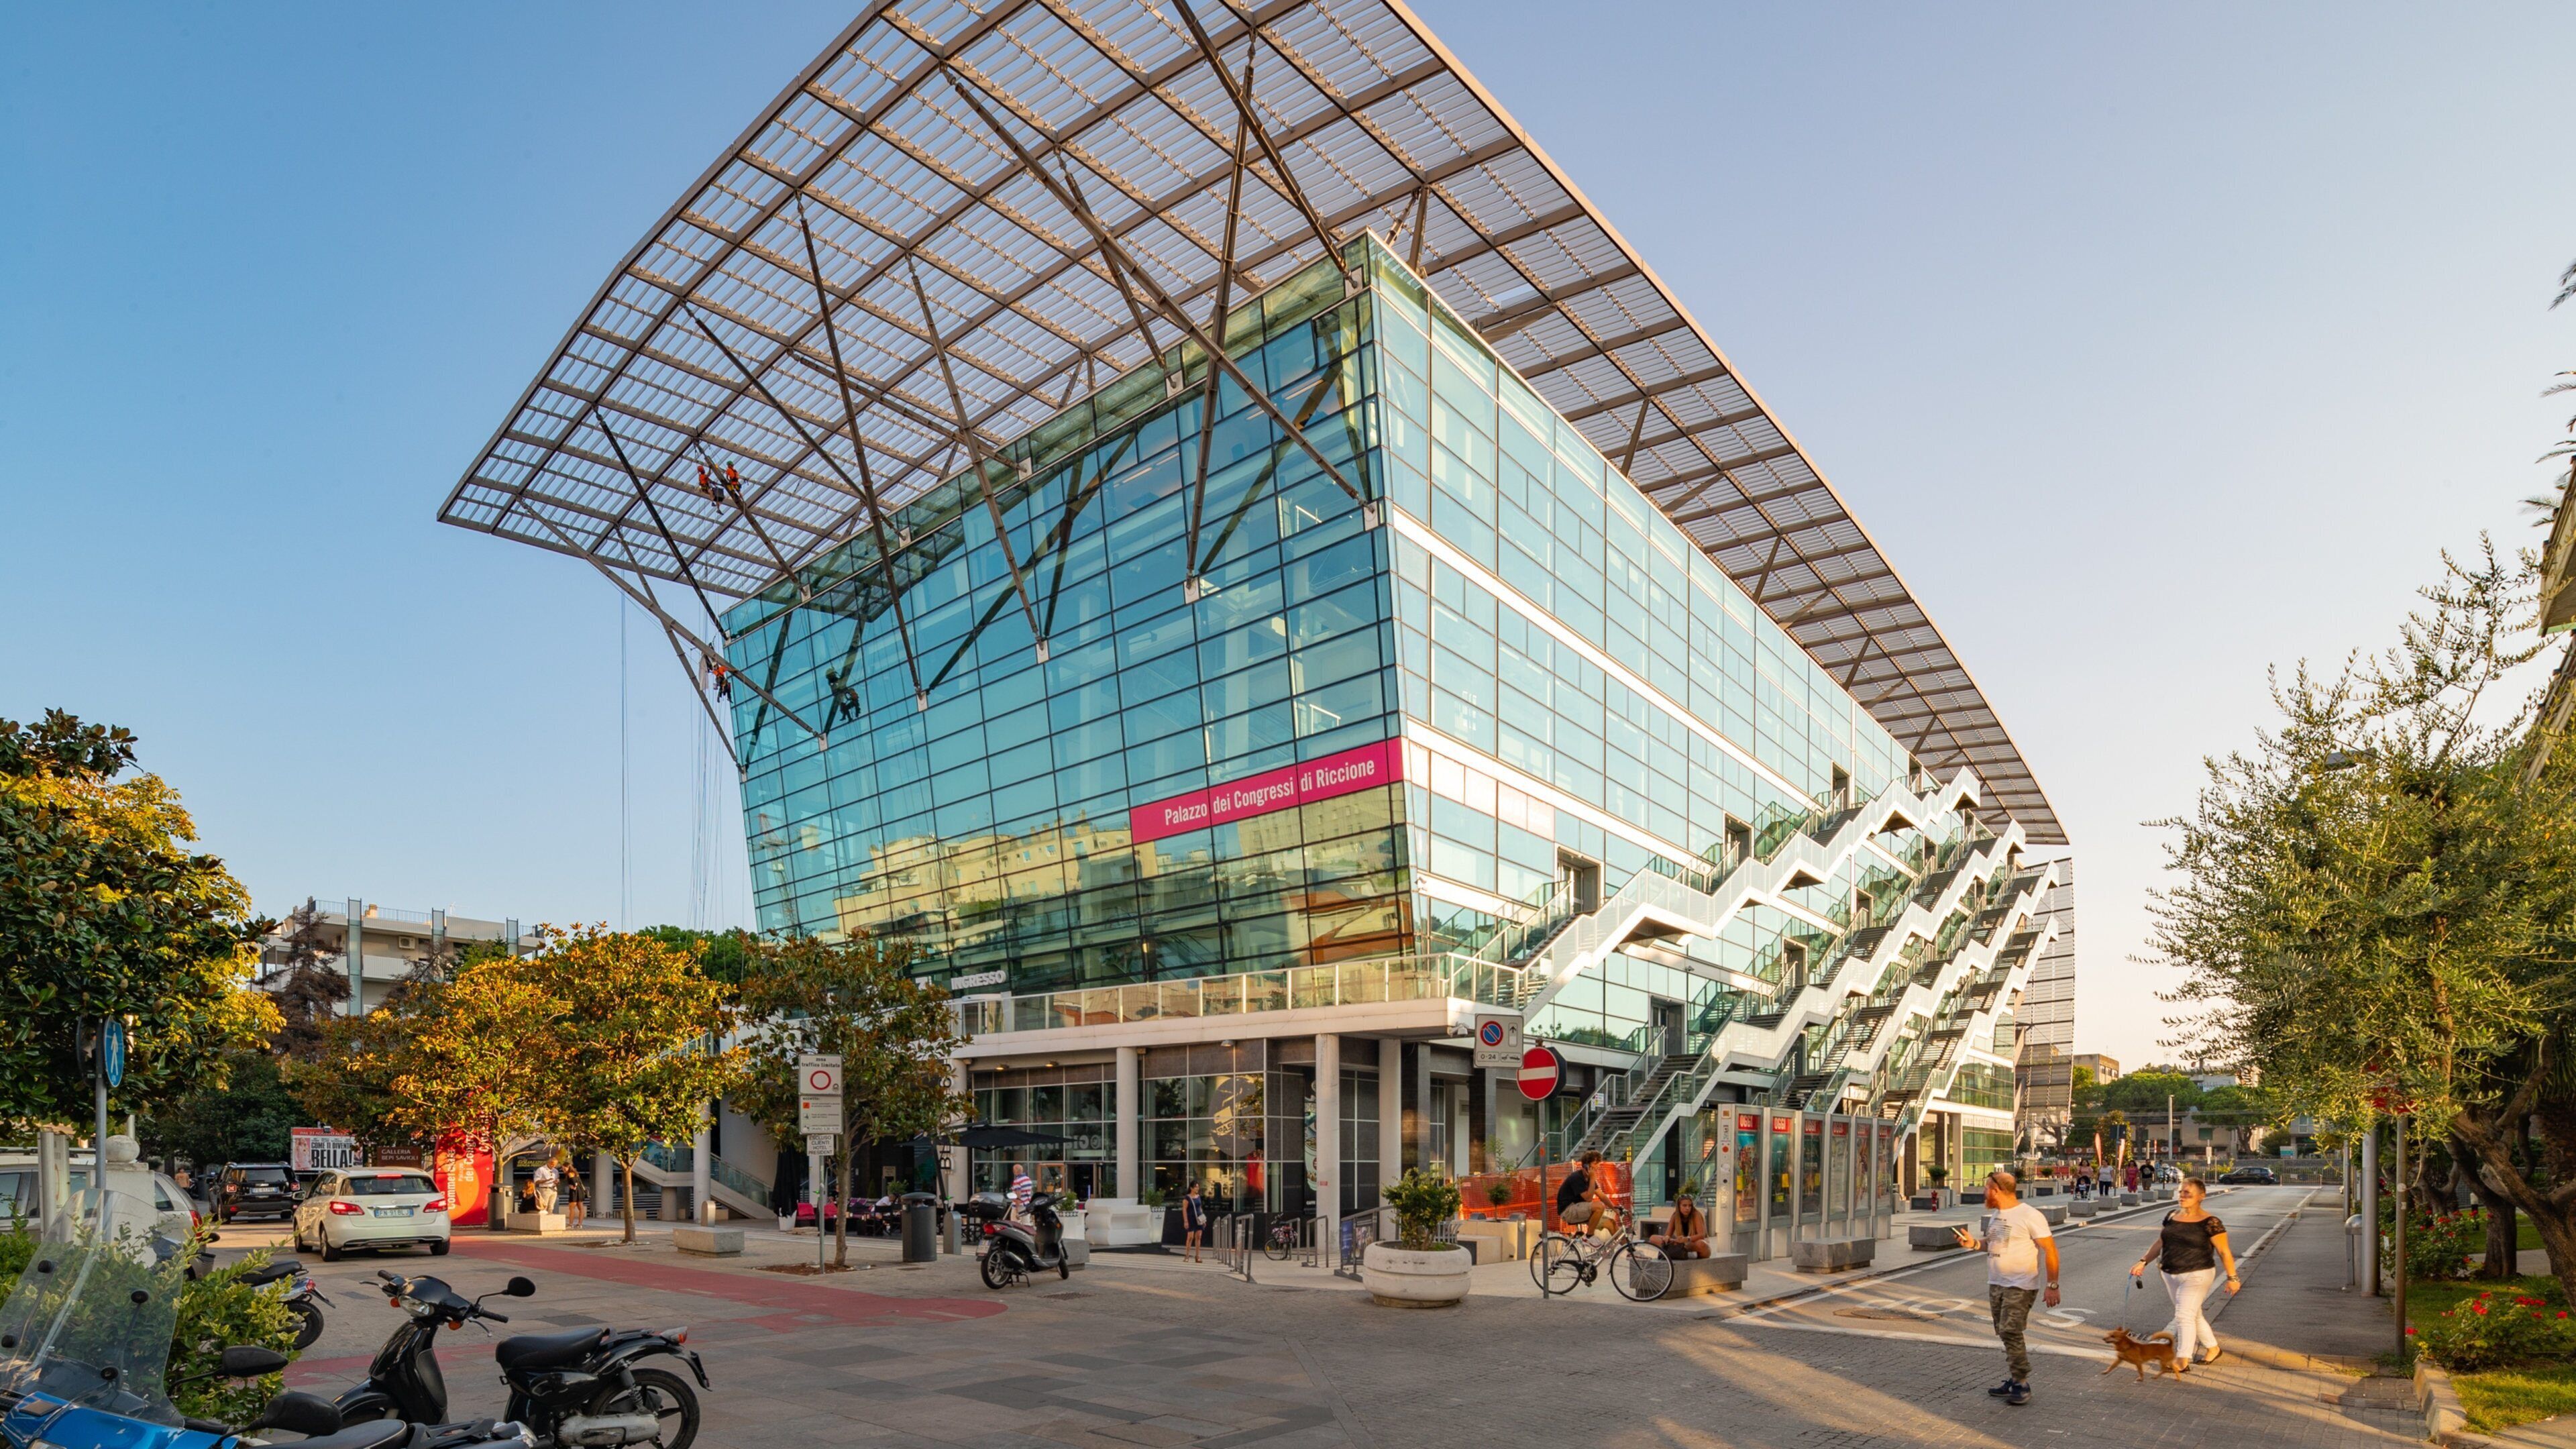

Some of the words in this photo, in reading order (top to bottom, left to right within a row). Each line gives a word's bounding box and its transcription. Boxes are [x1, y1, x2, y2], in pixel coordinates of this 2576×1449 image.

[1165, 803, 1208, 826] Palazzo
[1213, 794, 1231, 814] dei
[1233, 777, 1295, 808] Congressi
[1300, 773, 1313, 792] di
[1316, 759, 1375, 788] Riccione
[951, 970, 1006, 989] INGRESSO
[1739, 1115, 1753, 1128] OGGI
[1774, 1118, 1786, 1130] OGGI
[1805, 1120, 1817, 1132] OGGI
[311, 1149, 352, 1168] BELLA!
